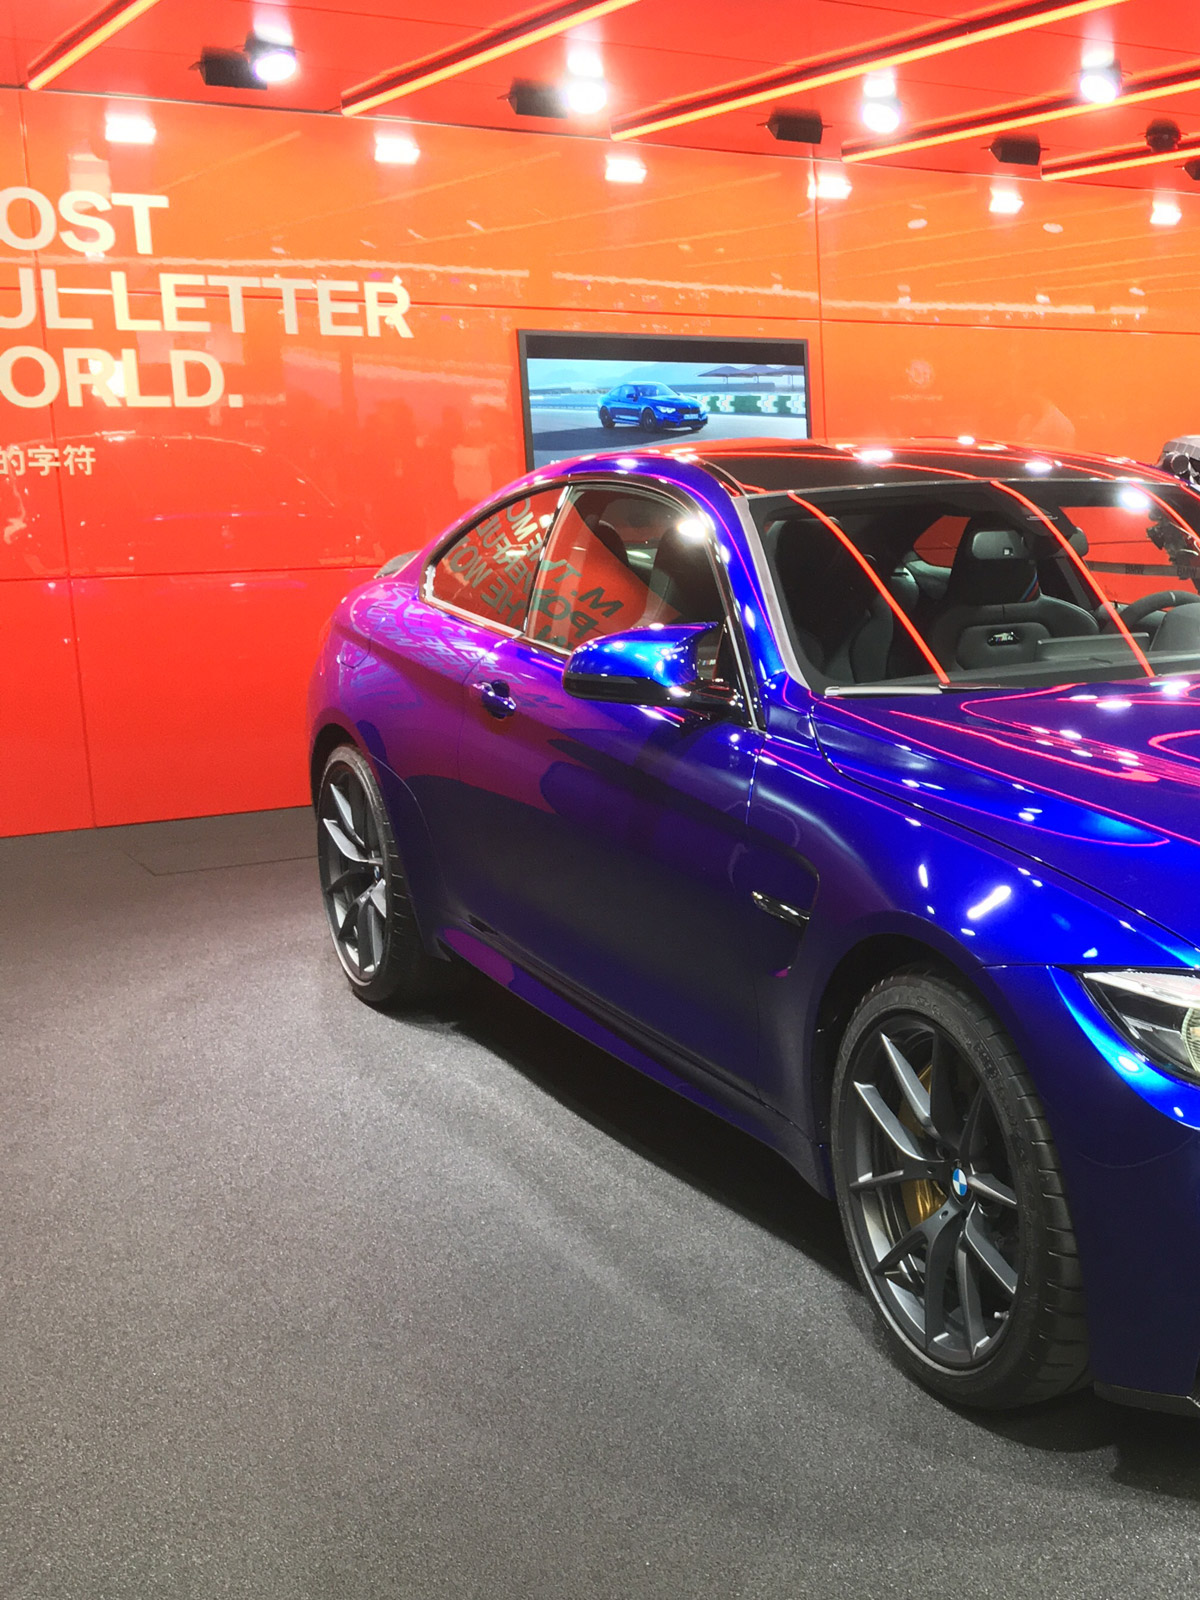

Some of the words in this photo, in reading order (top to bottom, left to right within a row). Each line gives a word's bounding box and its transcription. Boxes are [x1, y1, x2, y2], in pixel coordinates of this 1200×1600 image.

[0, 186, 169, 254] OST
[110, 271, 414, 338] LETTER
[0, 345, 244, 409] ORLD.
